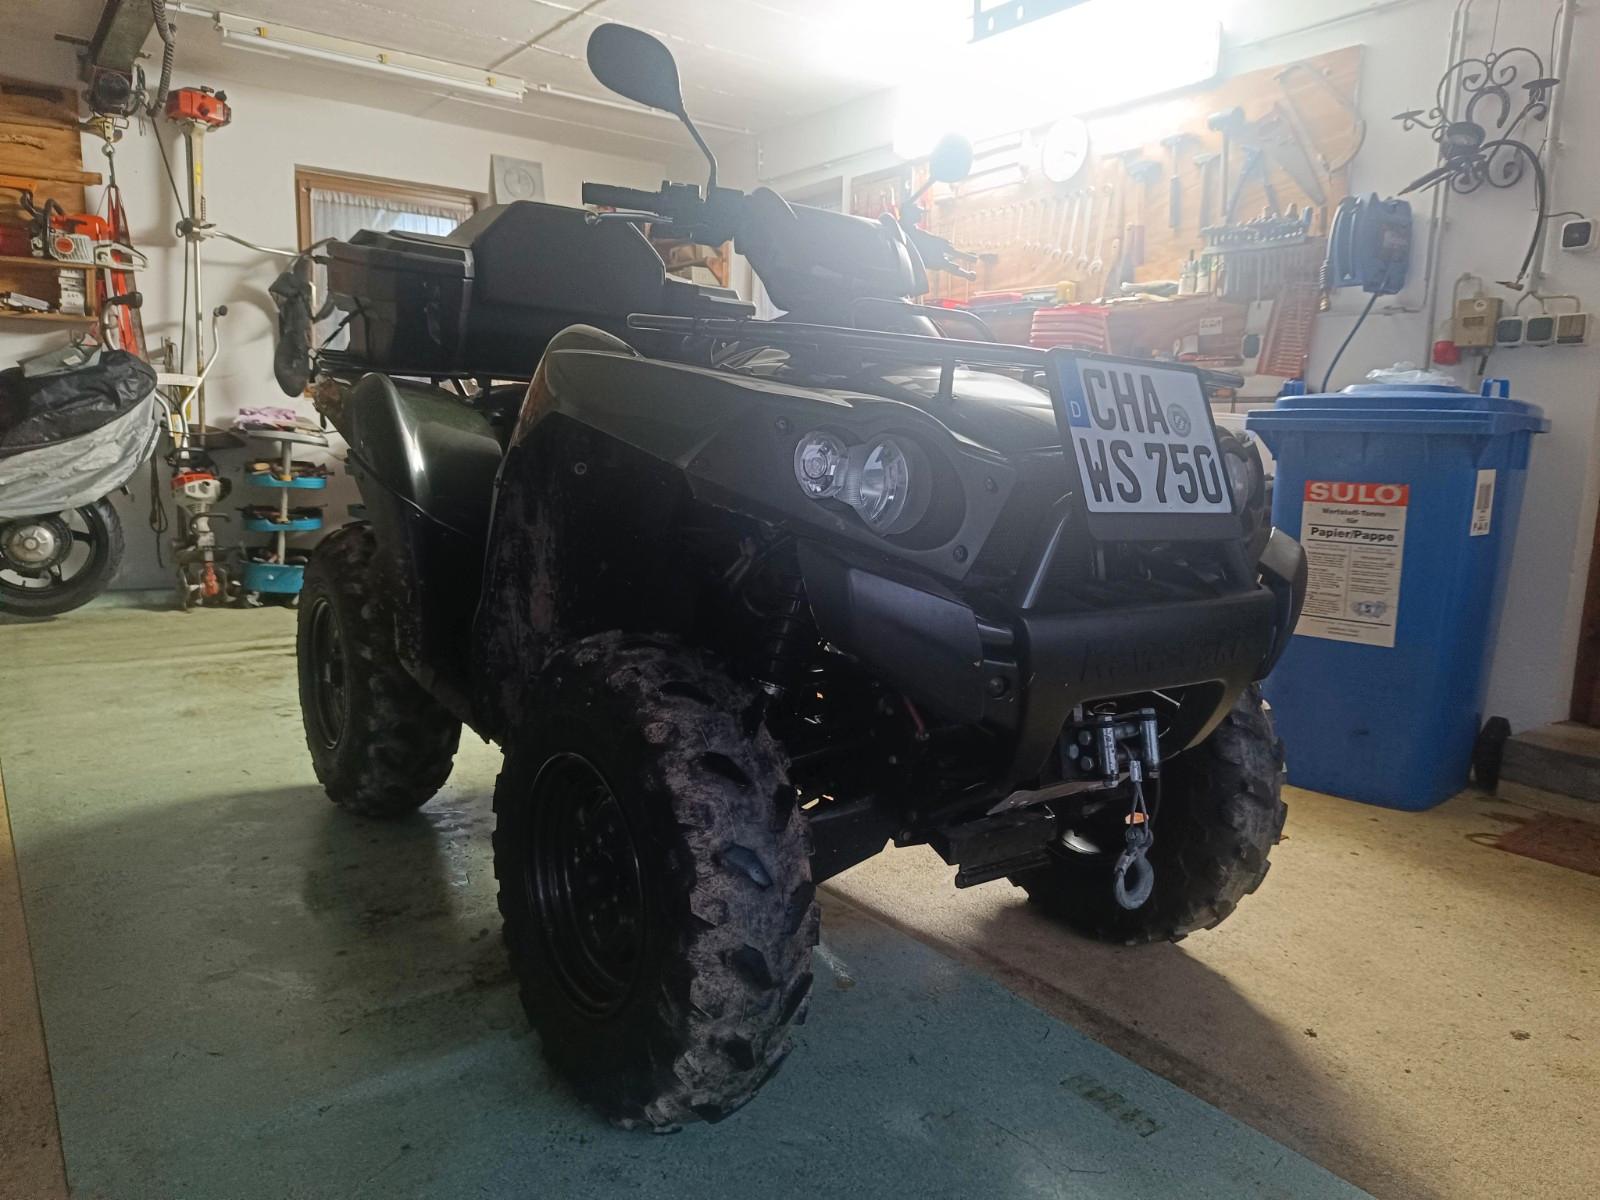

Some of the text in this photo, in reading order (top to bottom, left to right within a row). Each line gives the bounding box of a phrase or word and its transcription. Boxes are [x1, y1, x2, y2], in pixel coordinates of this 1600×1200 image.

[1070, 401, 1081, 418] D
[1083, 368, 1170, 435] CHA
[1080, 438, 1223, 504] WS 750
[1310, 482, 1402, 504] SULO
[1311, 527, 1394, 542] Papier/Pappe
